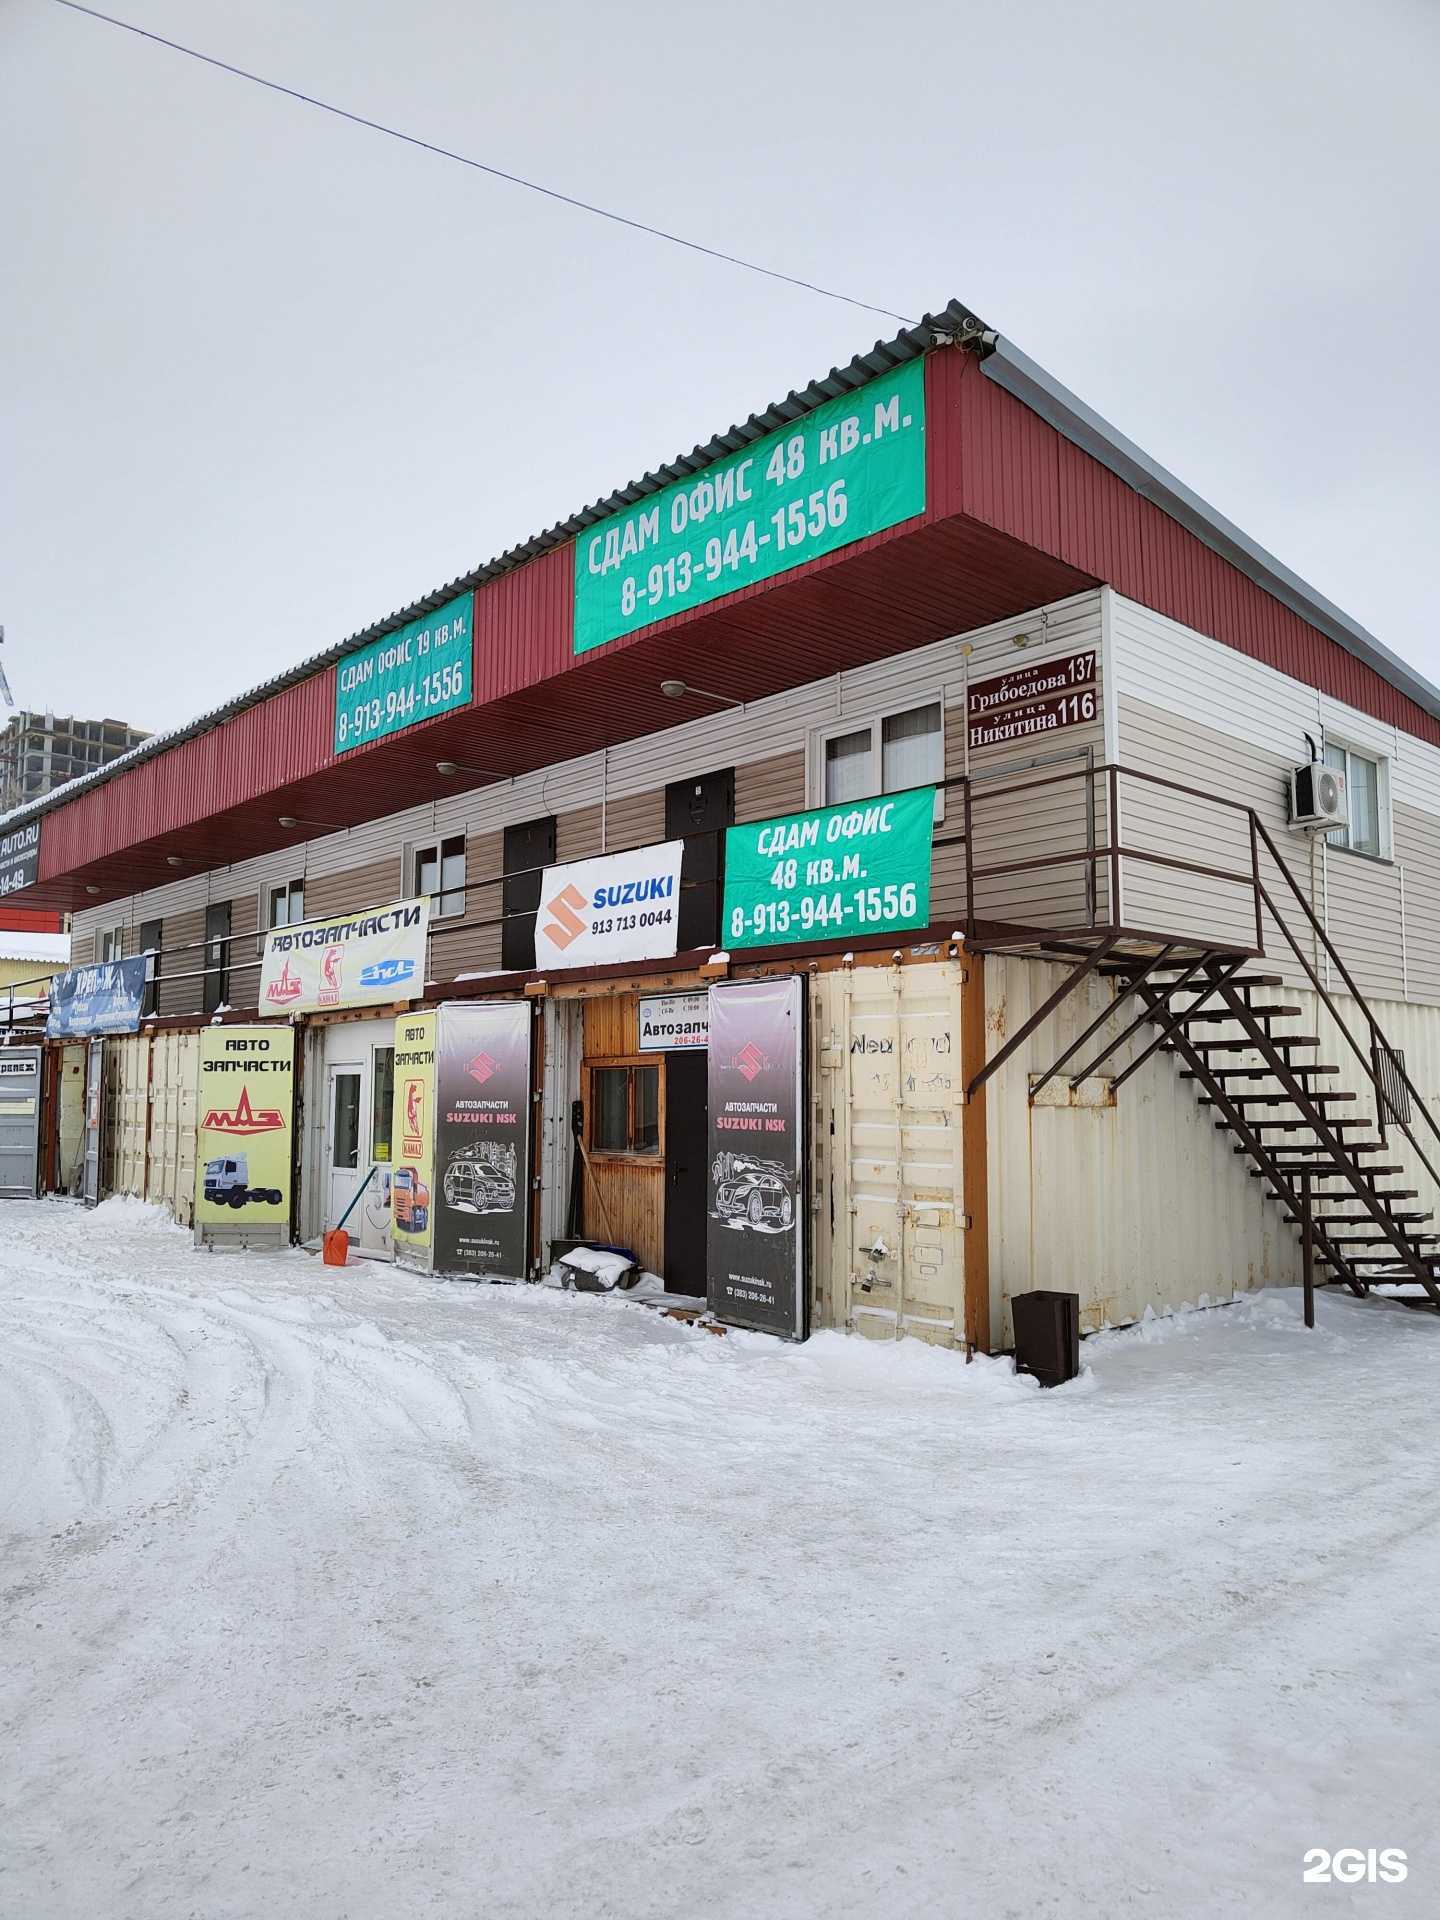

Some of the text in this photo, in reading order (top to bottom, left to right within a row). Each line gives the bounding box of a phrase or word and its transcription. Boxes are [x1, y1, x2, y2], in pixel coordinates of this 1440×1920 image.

[588, 506, 659, 576] СДАМ
[671, 458, 753, 534] ОФИС
[766, 435, 805, 487] 48
[621, 479, 848, 616] 8-913-944-1556
[341, 657, 374, 693] СДАМ
[378, 639, 412, 674] ОФИС
[417, 630, 430, 656] 19
[970, 654, 1094, 711] Грибоедова 137
[1002, 669, 1039, 686] улица
[338, 661, 463, 742] 8-913-944-1556
[994, 703, 1046, 724] улица
[970, 692, 1094, 747] Никитина 116
[757, 803, 894, 857] СДАМ ОФИС
[771, 859, 797, 890] 48
[592, 875, 673, 909] SUZUKI
[592, 908, 672, 935] 913 713 0044
[731, 883, 917, 937] 8-913-944-1556
[271, 905, 420, 952] АВТОЗАПЧАСТИ
[225, 1039, 270, 1051] АВТО
[404, 1027, 424, 1041] АВТО
[203, 1060, 291, 1072] ЗАПЧАСТИ
[395, 1050, 434, 1066] ЗАПЧАСТИ
[446, 1112, 517, 1124] SUZUKI NSK
[455, 1100, 509, 1109] АВТОЗАПЧАСТИ
[725, 1102, 777, 1113] АВТОЗАПЧАСТИ
[716, 1117, 786, 1132] SUZUKI NSK
